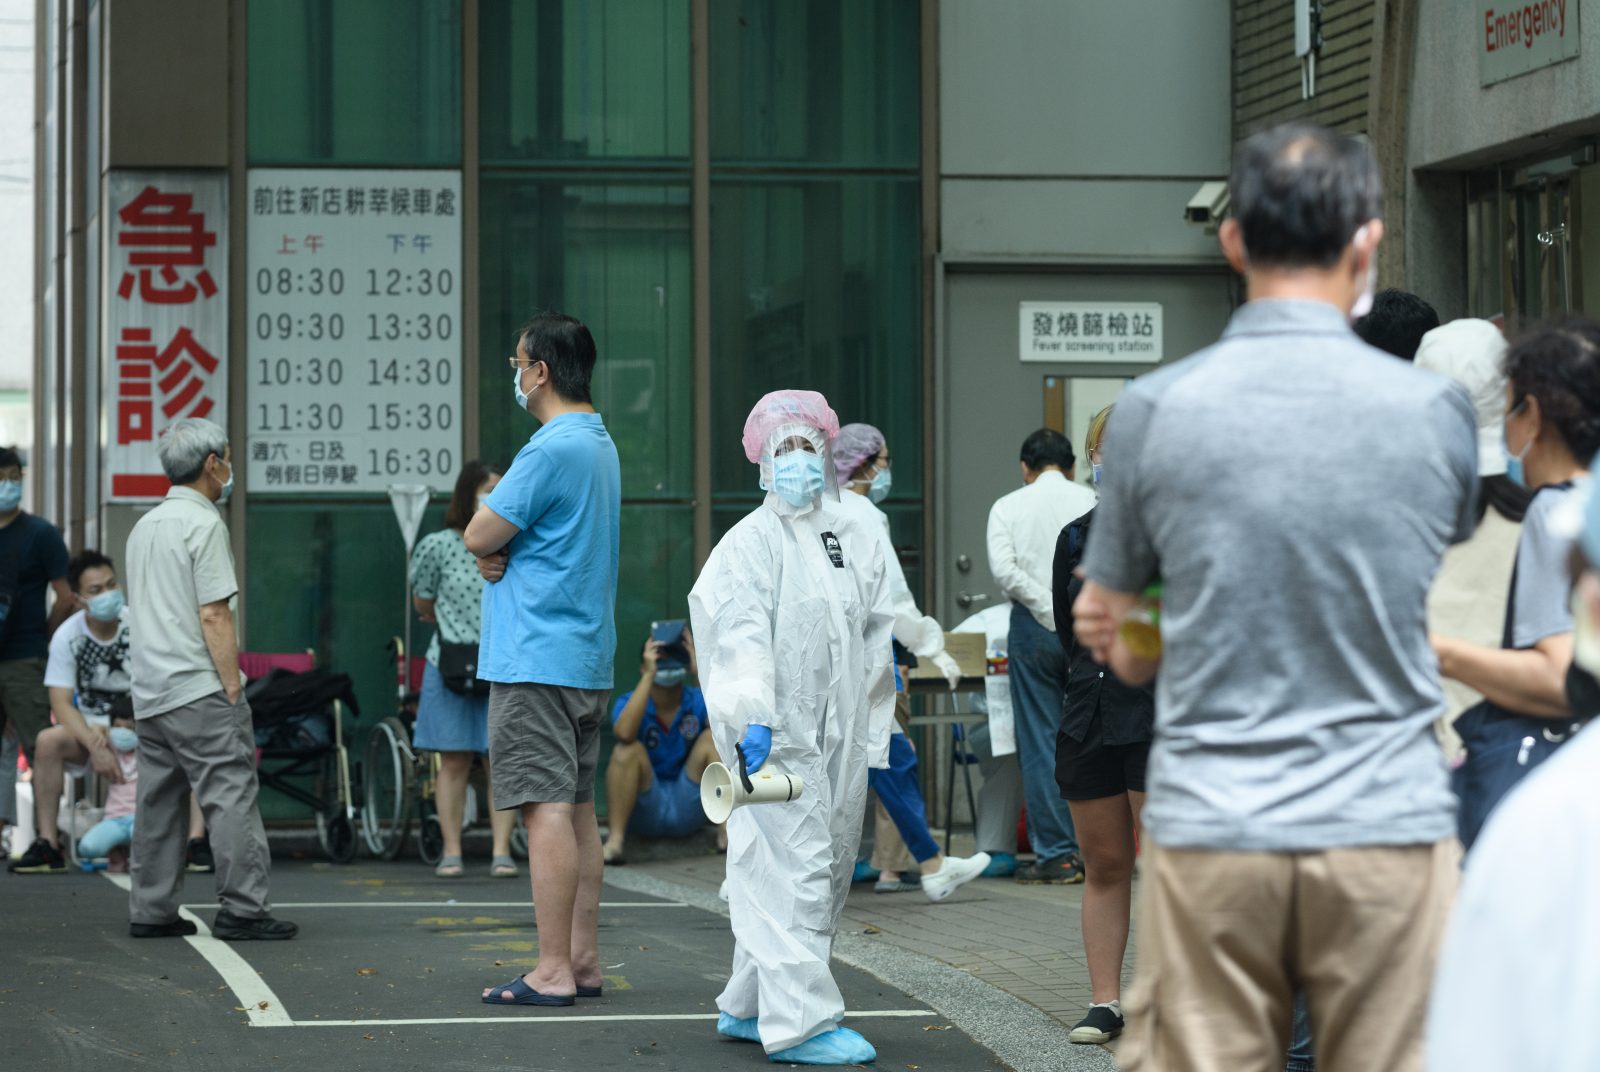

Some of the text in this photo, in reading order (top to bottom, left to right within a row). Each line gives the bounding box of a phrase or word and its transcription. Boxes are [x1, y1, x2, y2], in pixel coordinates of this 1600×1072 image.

[1485, 0, 1566, 52] Emergency
[253, 186, 456, 216] 前往新店耕莘候車處
[276, 234, 325, 255] 上午
[386, 234, 433, 255] 下午
[256, 267, 453, 296] 08:30 12:30
[116, 186, 219, 444] 急診
[256, 312, 453, 341] 09:30 13:30
[1032, 312, 1154, 337] 發燒篩檢站
[1033, 338, 1154, 354] Fever screening station
[256, 357, 453, 387] 10:30 14:30
[256, 402, 453, 432] 11:30 15:30
[264, 464, 359, 485] 例假日停駛
[367, 448, 453, 477] 16:30
